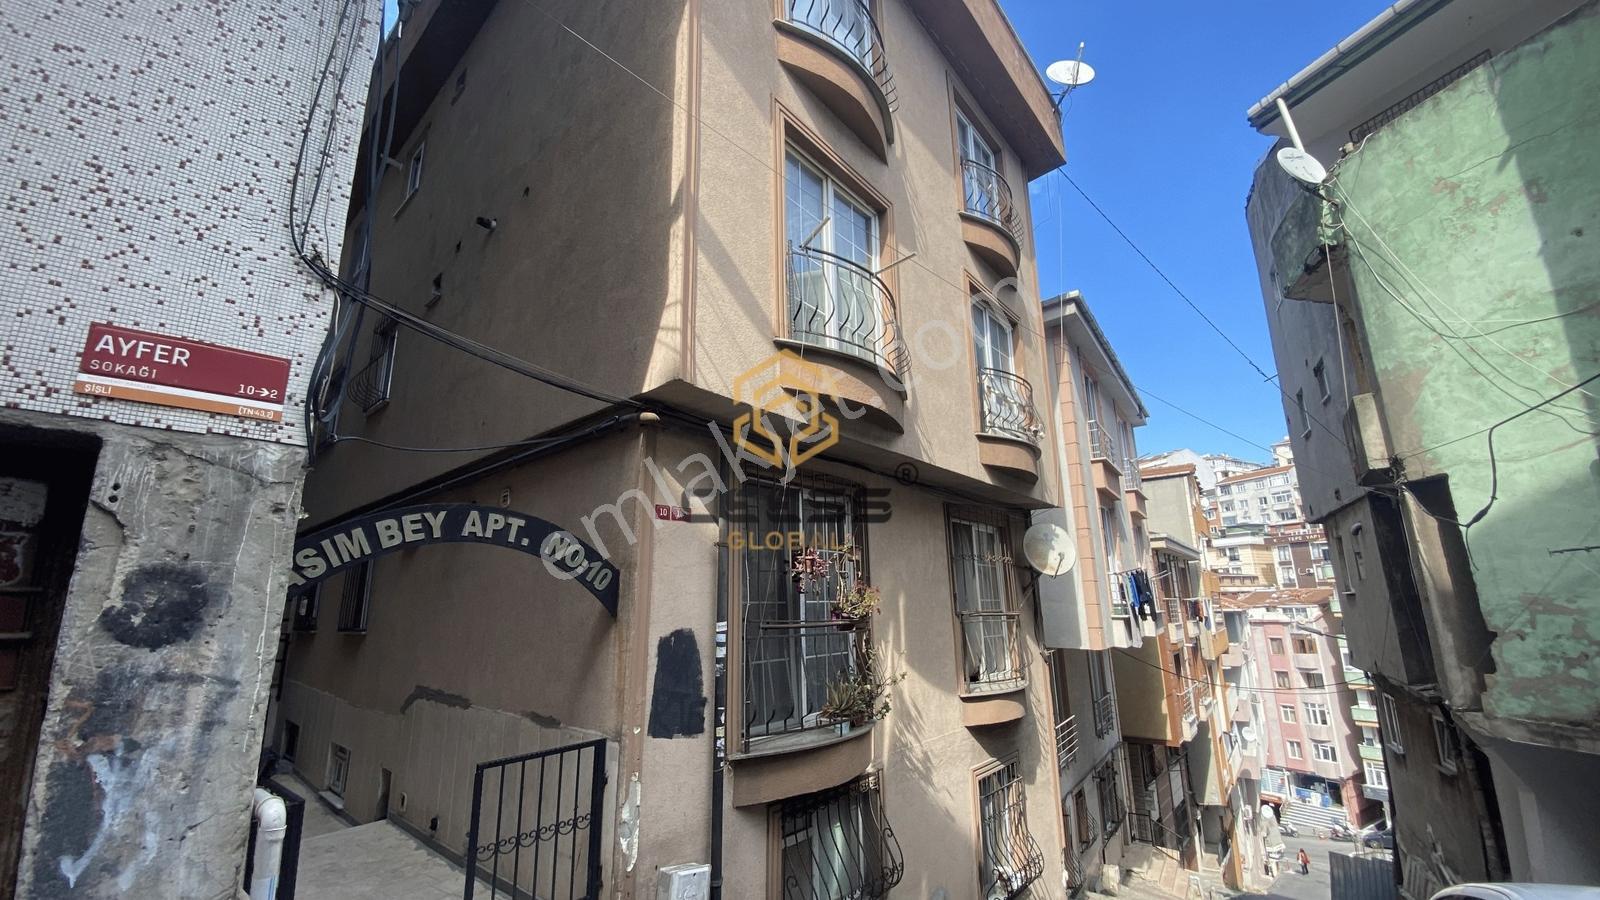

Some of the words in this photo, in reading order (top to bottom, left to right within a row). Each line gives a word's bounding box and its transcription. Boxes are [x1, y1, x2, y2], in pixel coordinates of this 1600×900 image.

[94, 334, 191, 367] AYFER
[89, 359, 157, 379] SOKAĞI
[660, 508, 668, 517] 10
[375, 510, 447, 549] BEY
[461, 510, 529, 546] APT.
